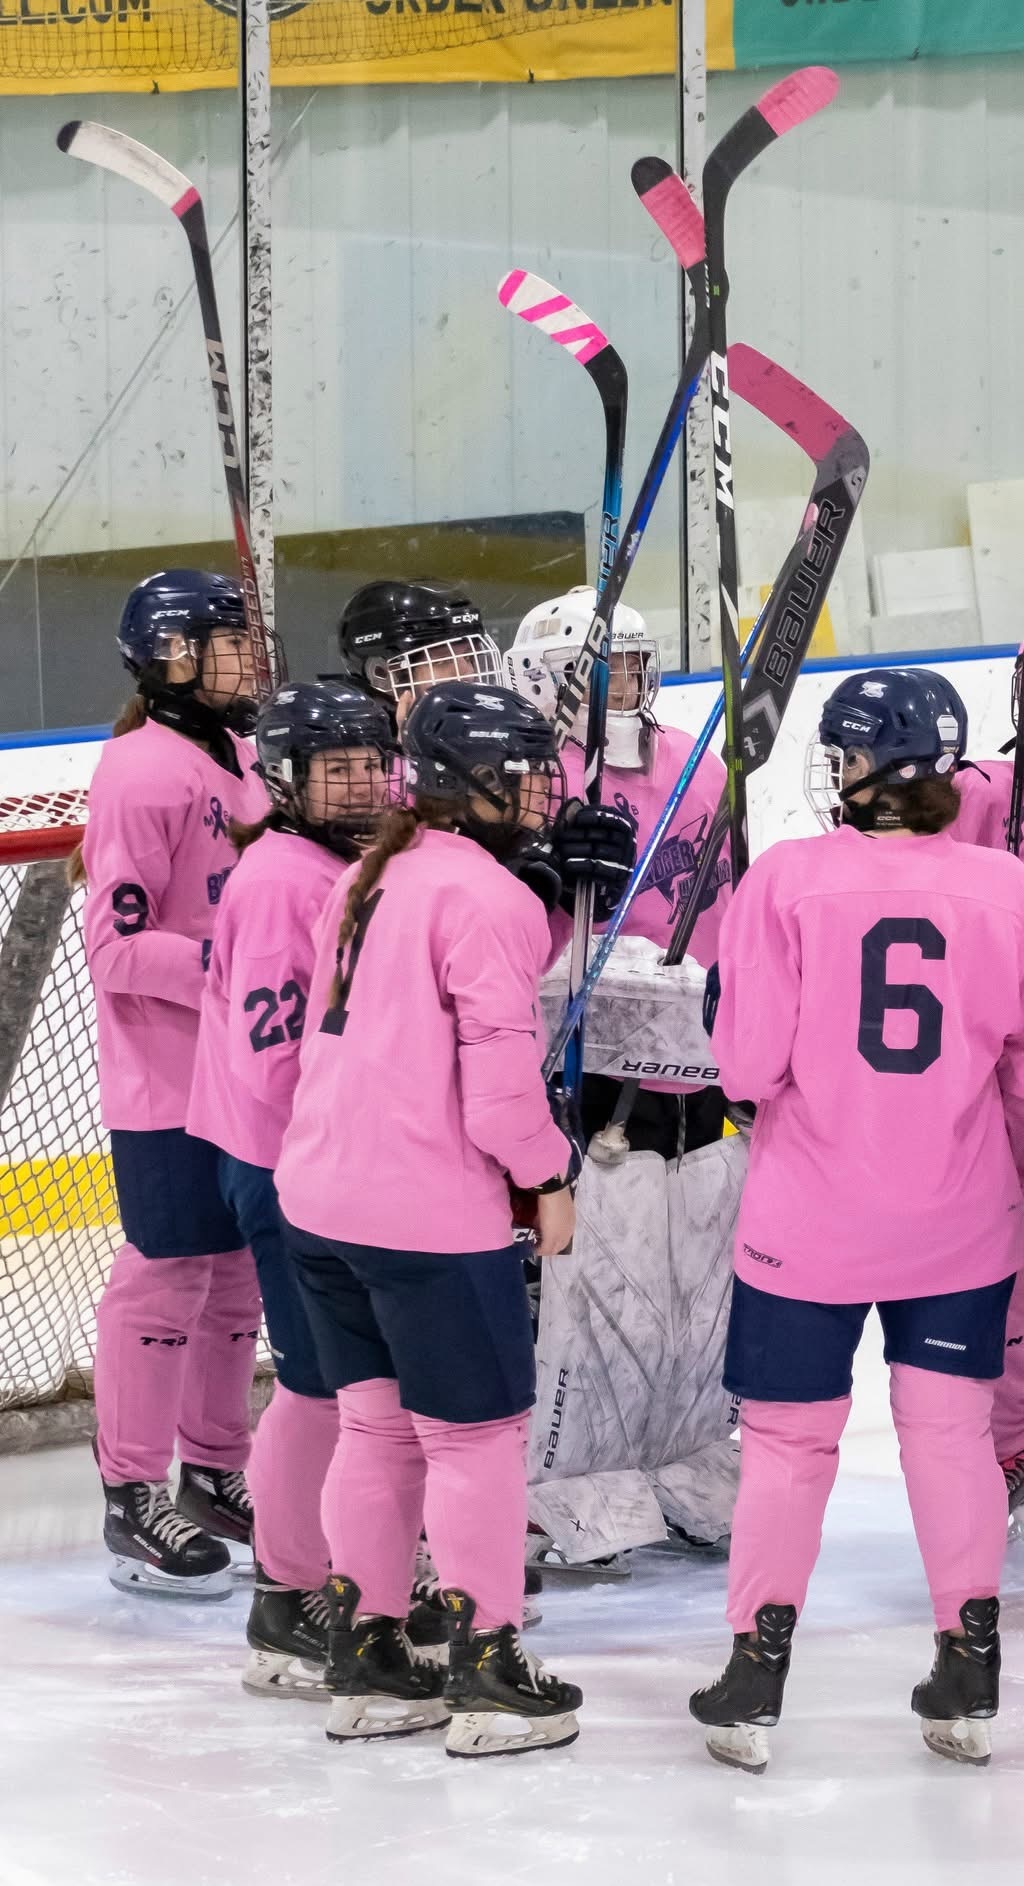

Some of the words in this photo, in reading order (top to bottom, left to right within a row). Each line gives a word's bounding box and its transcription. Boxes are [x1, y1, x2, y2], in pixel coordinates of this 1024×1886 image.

[206, 338, 240, 469] CCM
[710, 351, 735, 510] CCM
[763, 500, 846, 688] BAUER
[151, 608, 190, 620] CCM
[452, 613, 479, 624] CCM
[354, 632, 383, 644] CCM
[469, 730, 509, 739] BAUER
[842, 720, 871, 733] CCM
[112, 882, 149, 937] 9
[857, 917, 947, 1075] 6
[244, 979, 307, 1053] 22
[621, 1059, 720, 1080] BAUER
[140, 1335, 188, 1346] TRO
[544, 1368, 569, 1469] BAUER
[133, 1534, 163, 1559] BAUER
